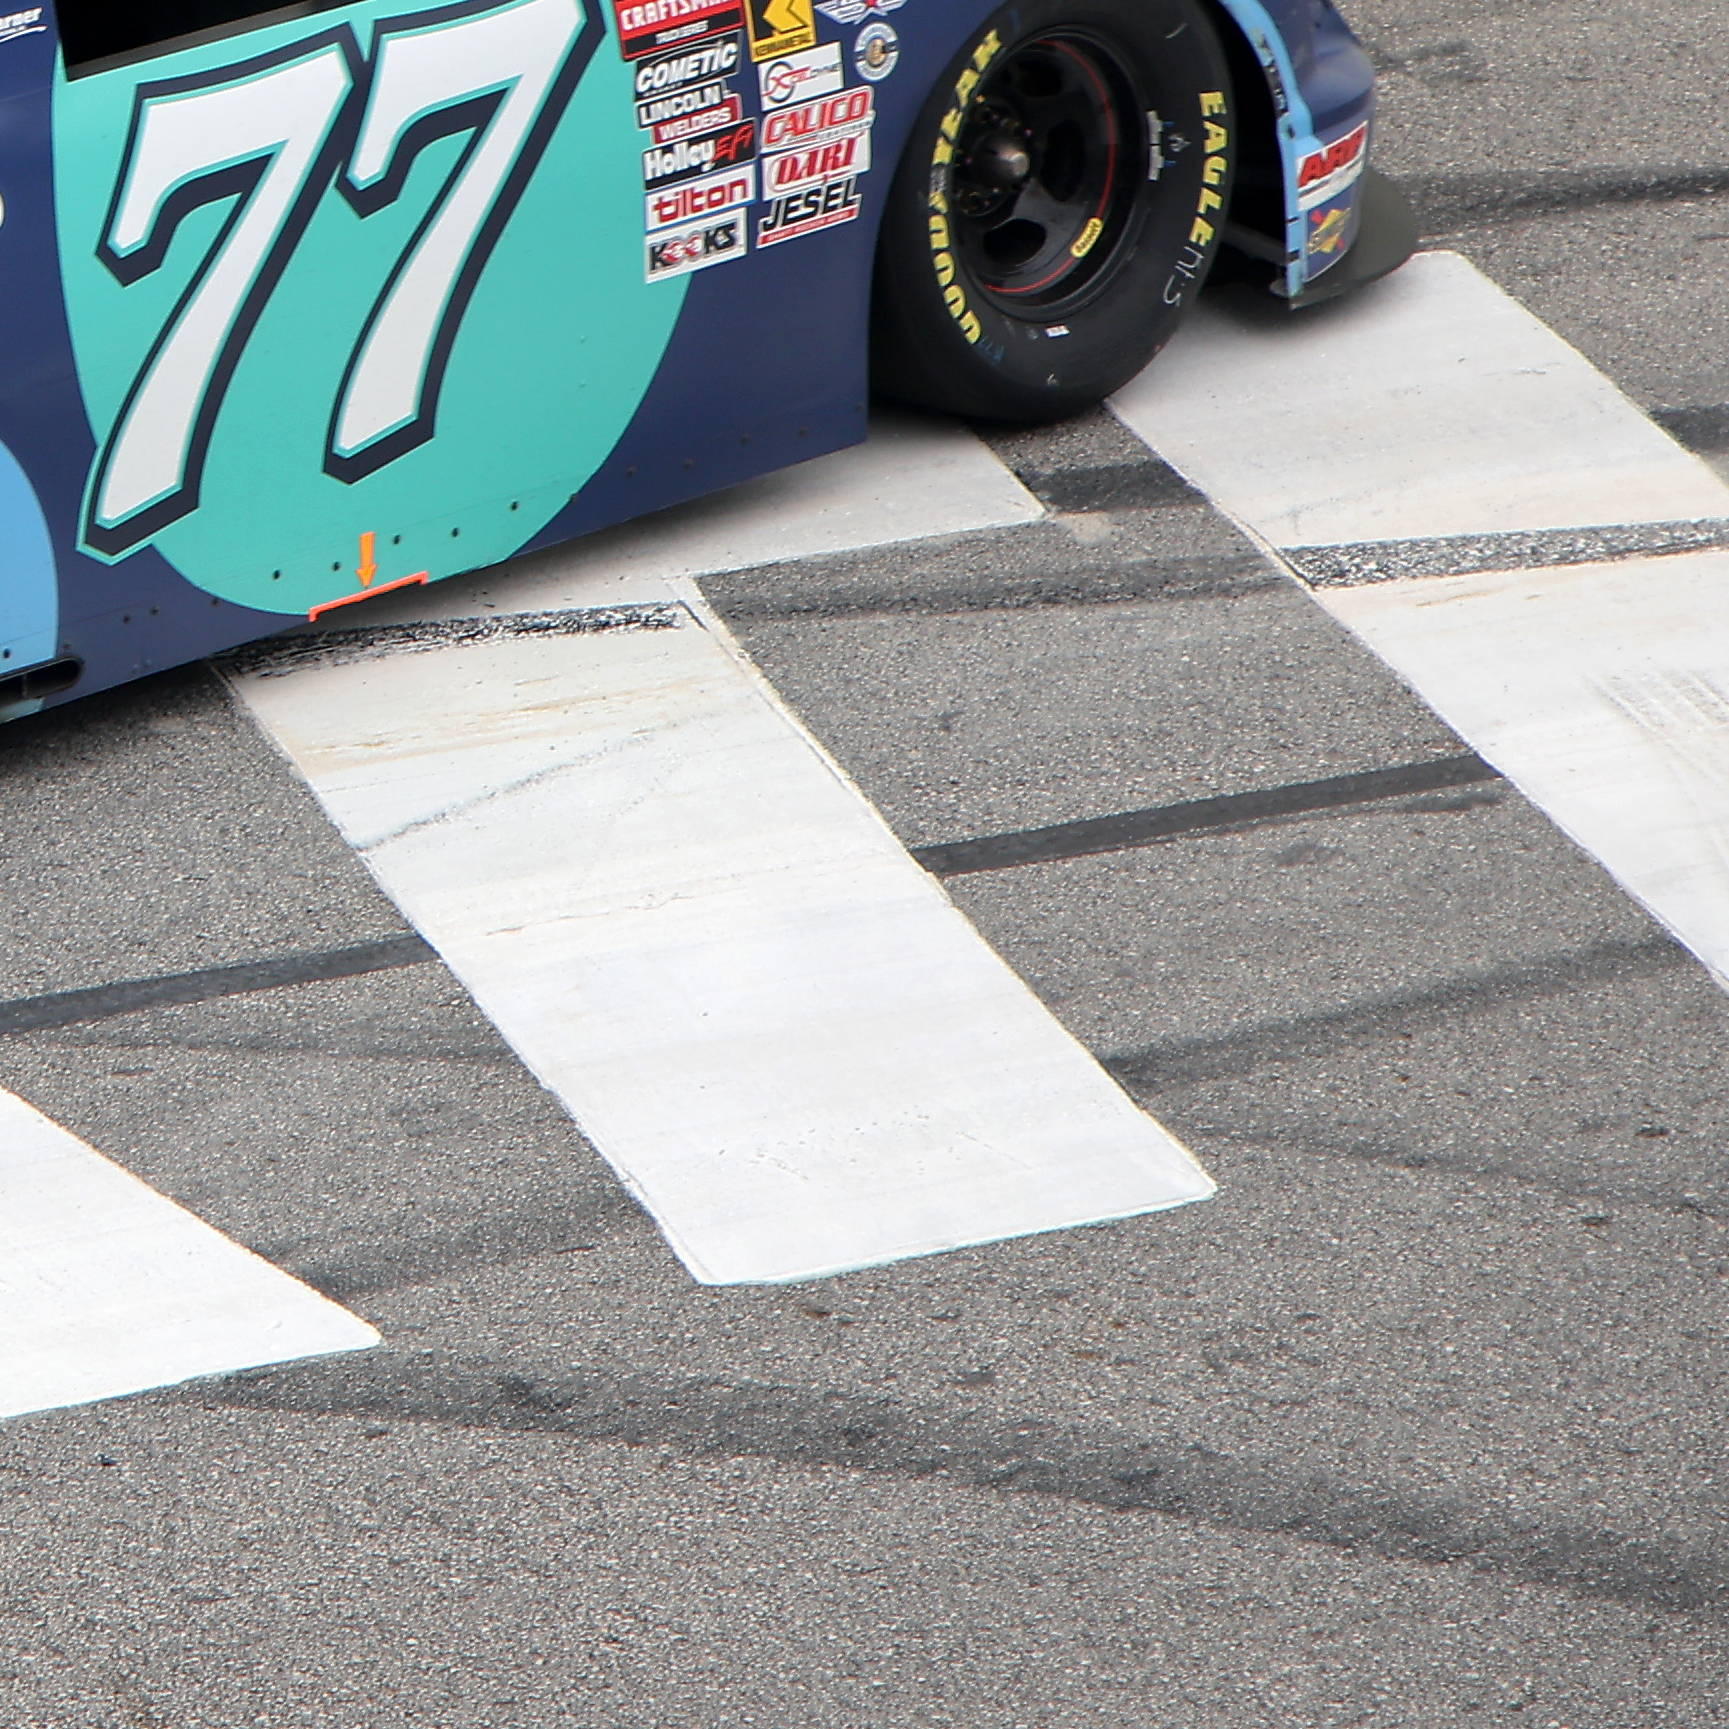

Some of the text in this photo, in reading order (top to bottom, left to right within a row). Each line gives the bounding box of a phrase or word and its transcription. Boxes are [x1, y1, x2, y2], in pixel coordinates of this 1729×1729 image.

[635, 42, 739, 94] COMETIC
[640, 85, 722, 127] LINCOLN
[658, 106, 733, 142] WELDERS
[766, 88, 870, 145] CALICO
[644, 122, 755, 181] Holley EFI
[1190, 90, 1229, 247] EAGLE
[652, 178, 747, 224] tilton
[763, 185, 857, 232] JESEL
